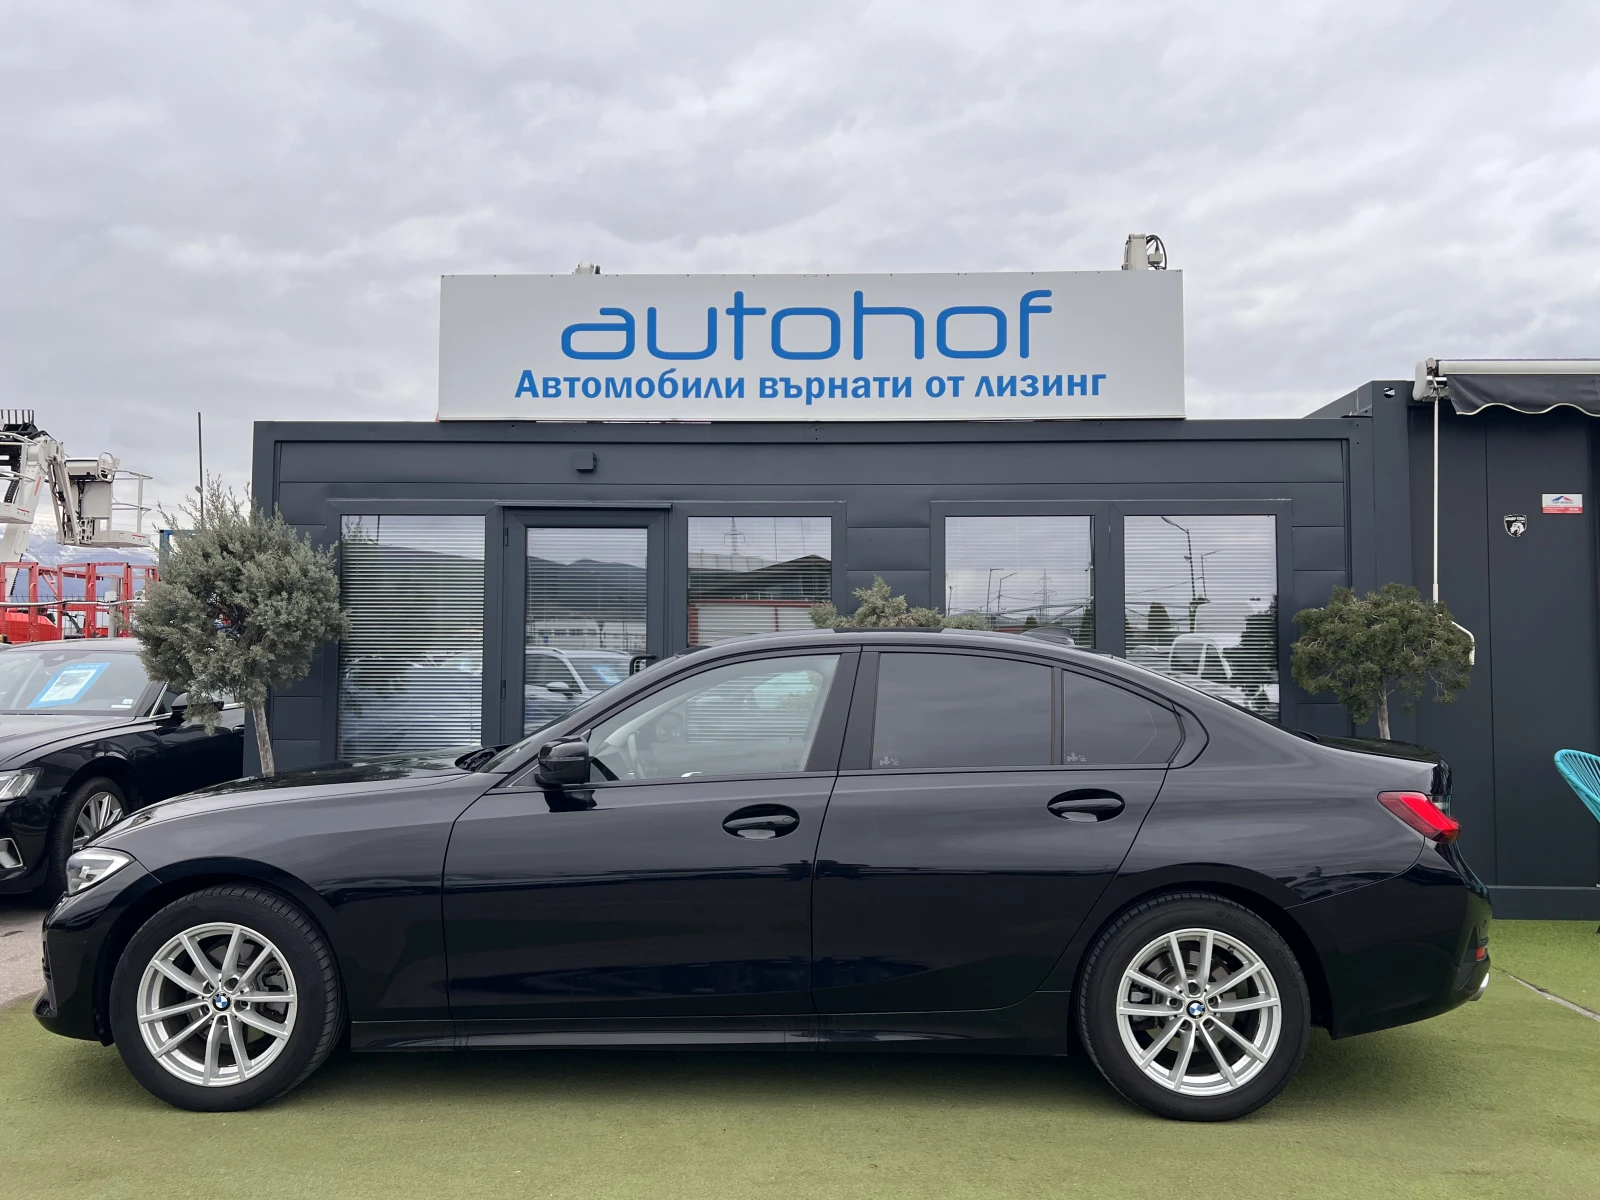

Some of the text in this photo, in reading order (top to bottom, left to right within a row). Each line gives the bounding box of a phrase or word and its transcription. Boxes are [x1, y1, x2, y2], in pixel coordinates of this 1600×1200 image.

[561, 290, 1053, 361] autohof
[515, 368, 1107, 405] Автомобили върнати от лизинг
